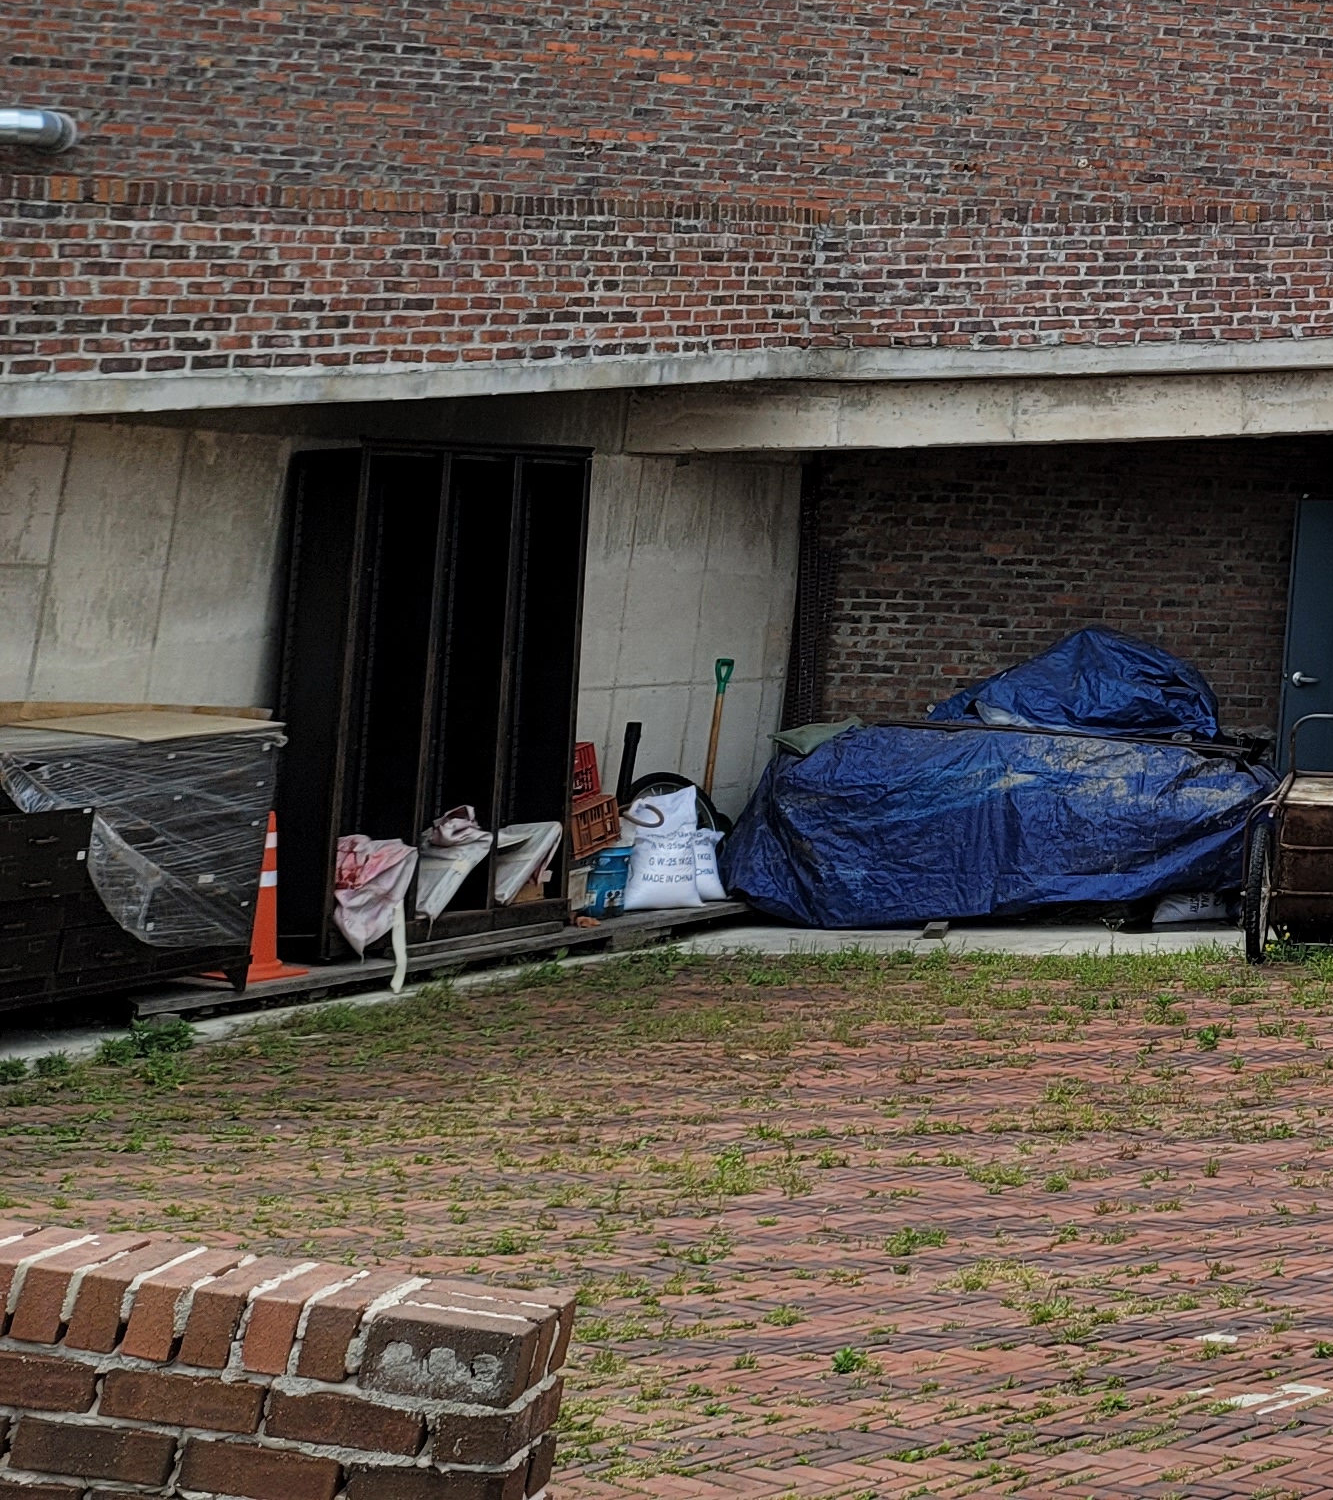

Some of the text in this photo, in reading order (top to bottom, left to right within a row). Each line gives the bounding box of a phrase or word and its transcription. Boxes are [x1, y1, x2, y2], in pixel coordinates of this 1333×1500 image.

[642, 873, 693, 883] MADE IN CHINA
